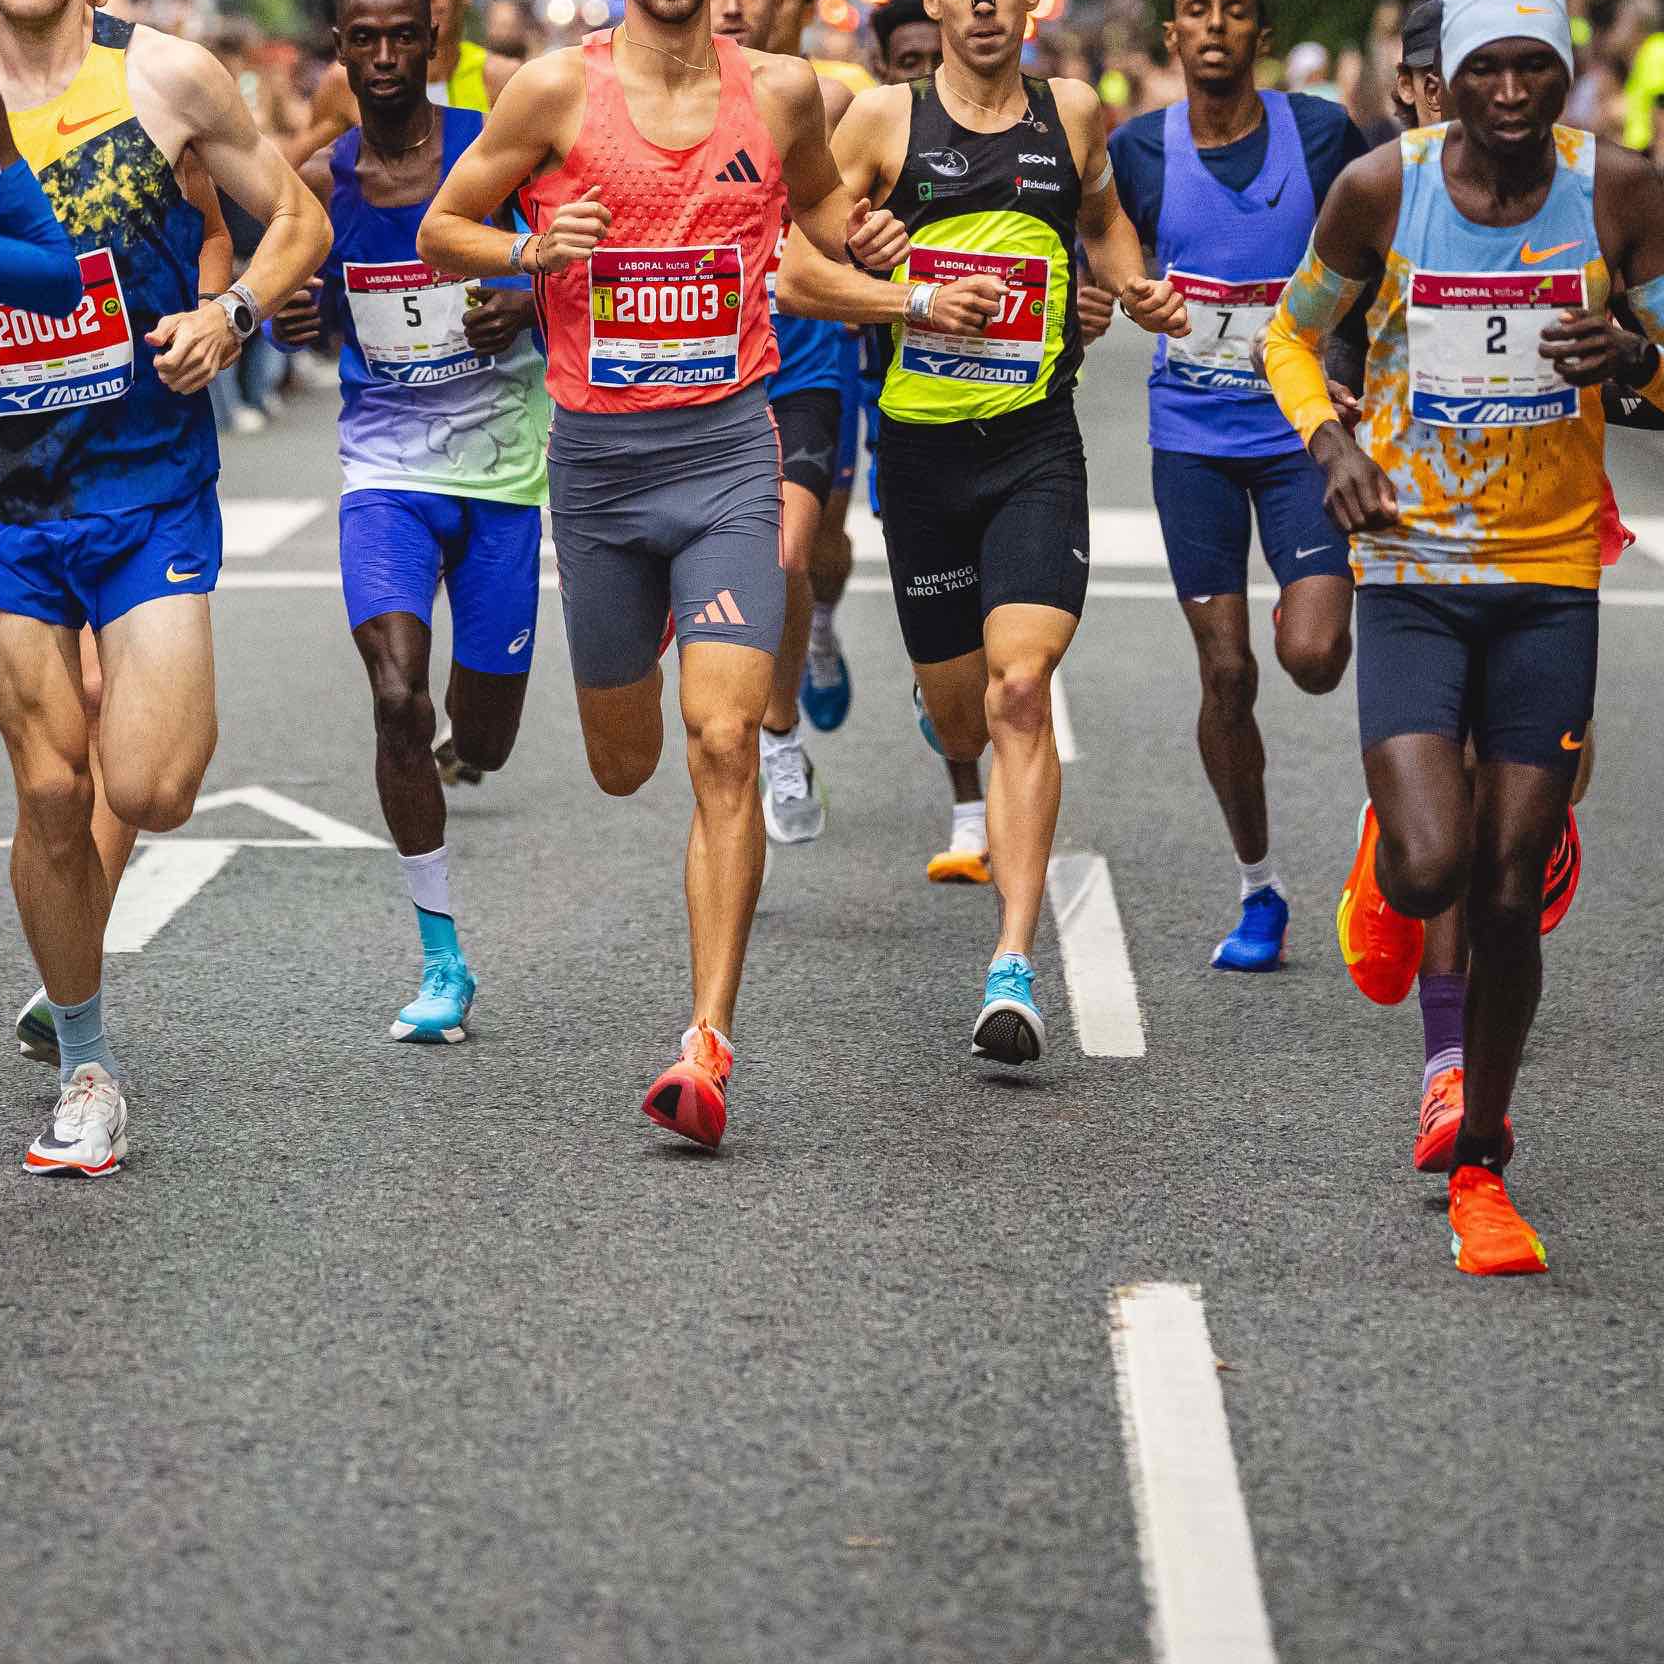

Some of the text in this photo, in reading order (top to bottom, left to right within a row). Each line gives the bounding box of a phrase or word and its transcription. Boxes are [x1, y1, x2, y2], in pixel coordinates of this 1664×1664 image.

[619, 262, 690, 271] LABORAL kutxa
[934, 260, 1002, 274] LABORAL kutxa
[365, 274, 402, 284] LABORAL
[1440, 287, 1492, 297] LABORAL
[403, 295, 422, 328] 5
[616, 284, 719, 323] 20003
[1217, 311, 1233, 339] 7
[1487, 316, 1507, 354] 2
[906, 573, 981, 597] KIROL TALDE
[913, 565, 974, 586] DURANGO
